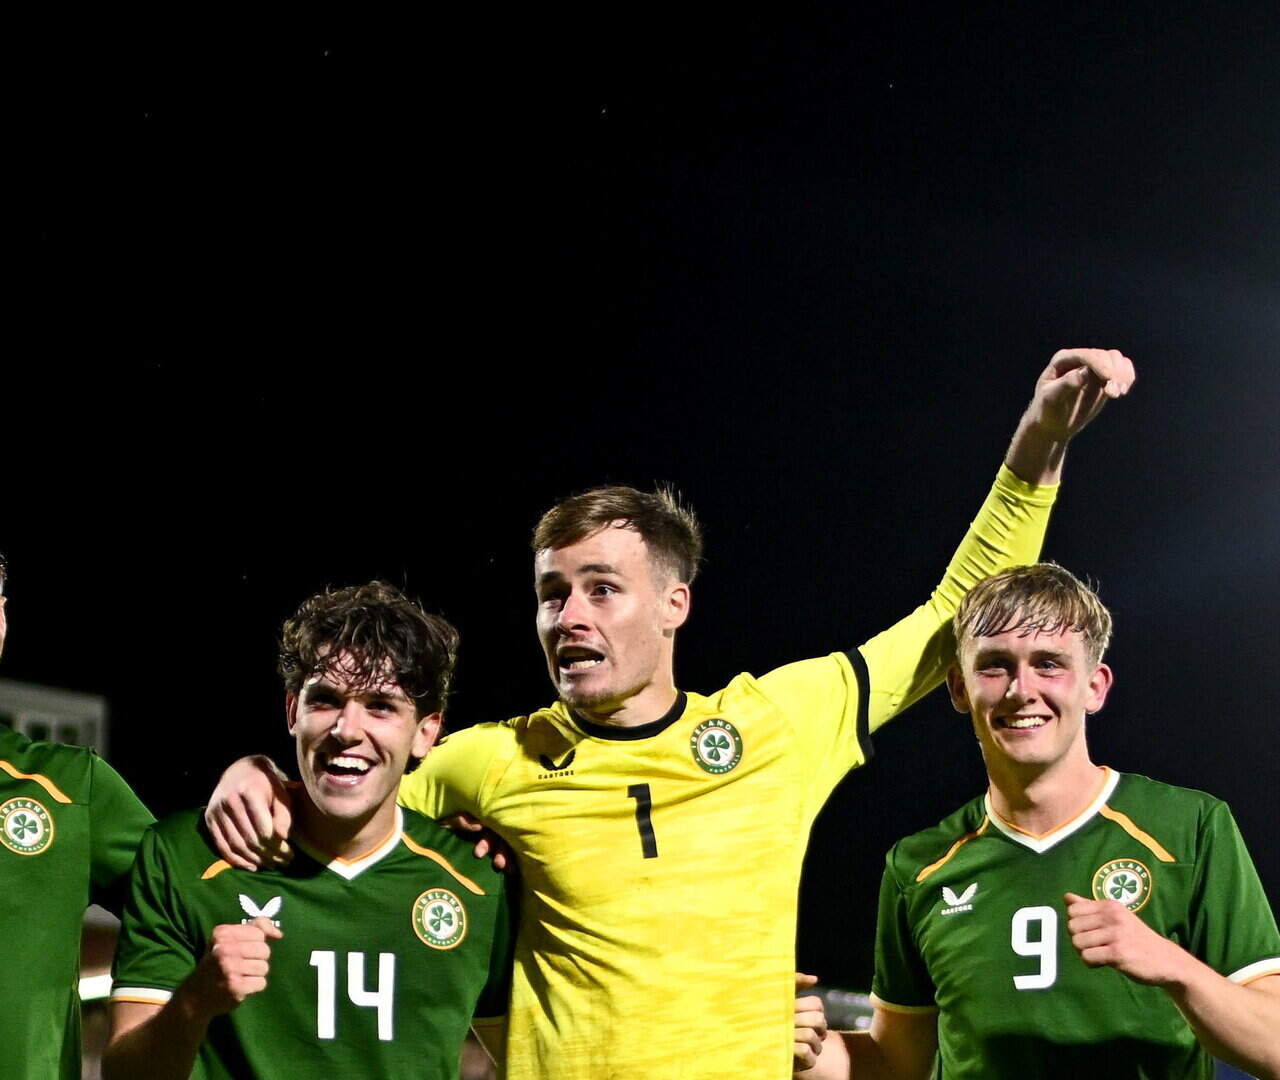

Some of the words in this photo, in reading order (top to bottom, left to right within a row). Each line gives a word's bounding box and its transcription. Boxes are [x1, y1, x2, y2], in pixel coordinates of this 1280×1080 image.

[691, 720, 732, 749] IRELAND
[537, 770, 575, 780] CASTORE
[0, 801, 47, 820] IRELAND
[626, 783, 659, 859] 1
[1098, 862, 1148, 879] IRELAND
[417, 892, 461, 913] IRELAND
[1010, 905, 1058, 990] 9
[308, 950, 396, 1041] 14
